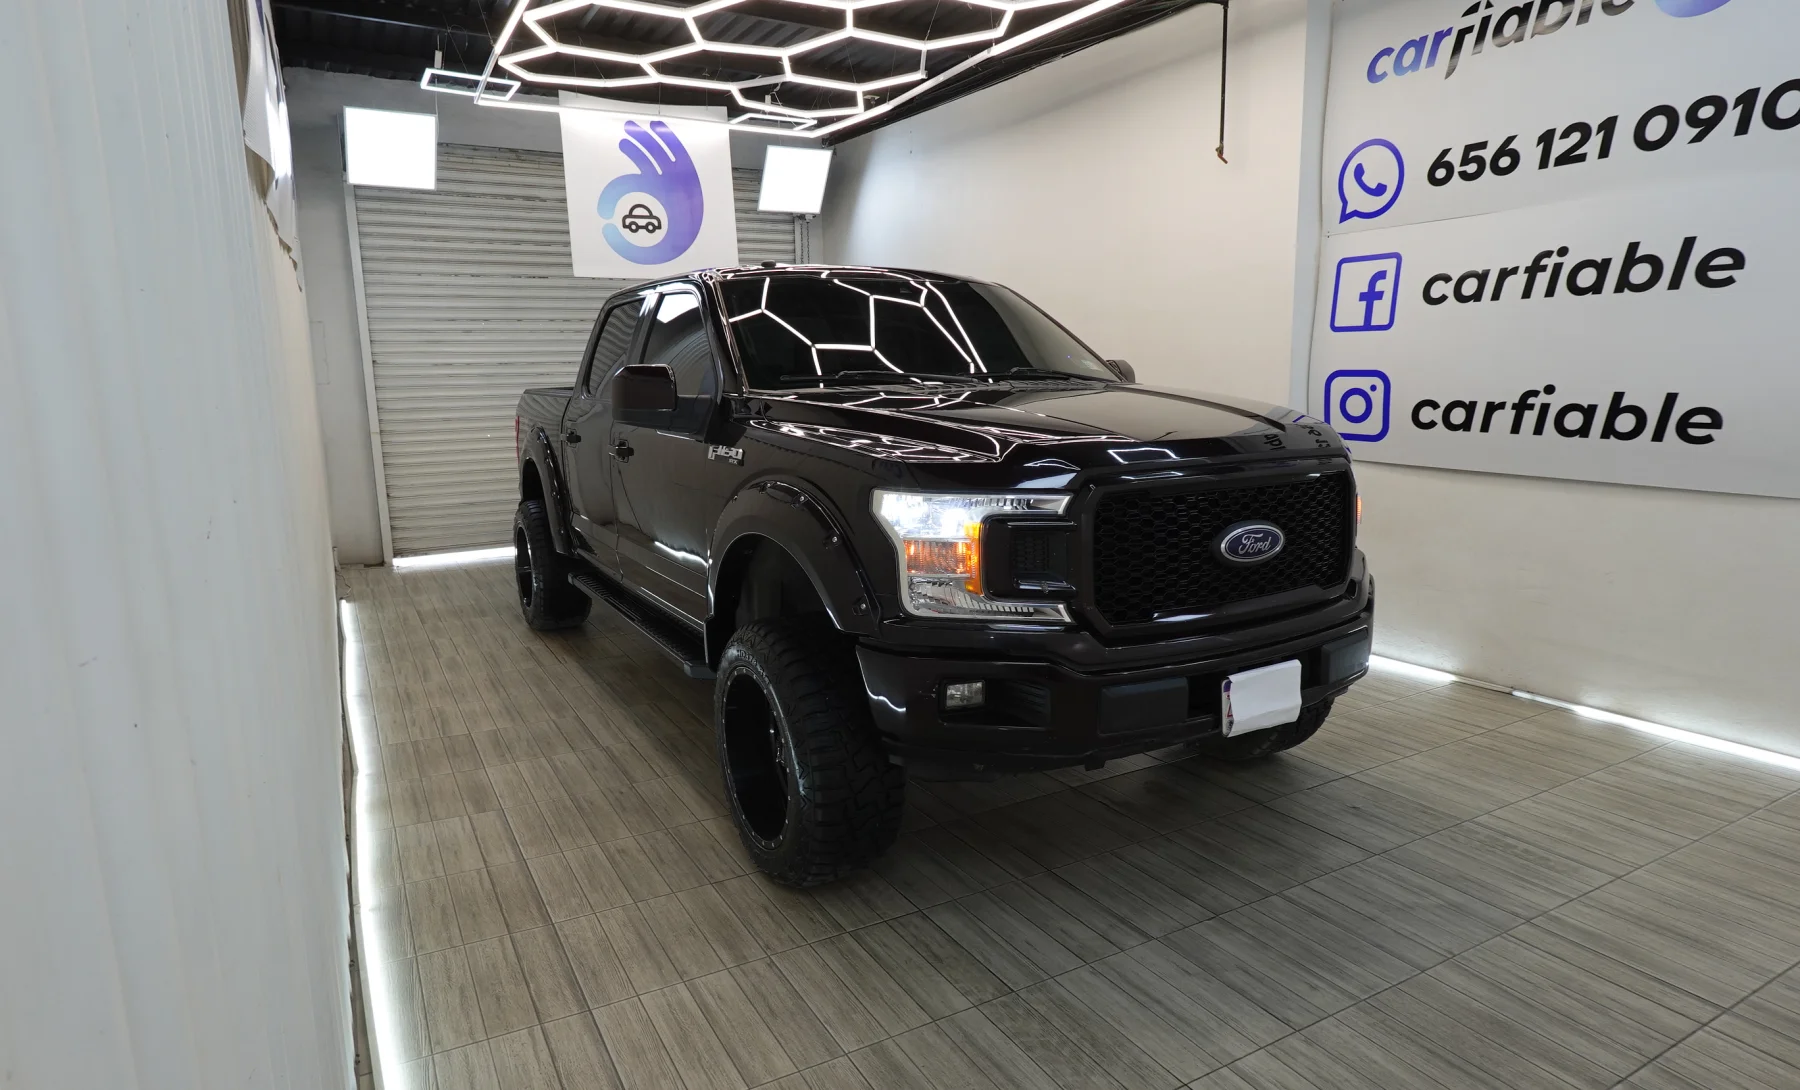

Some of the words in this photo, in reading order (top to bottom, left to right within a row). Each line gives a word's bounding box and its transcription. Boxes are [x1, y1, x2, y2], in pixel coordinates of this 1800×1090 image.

[1427, 134, 1521, 187] 656
[1536, 115, 1619, 170] 121
[1633, 78, 1800, 152] 0910
[1422, 235, 1746, 306] carfiable
[1410, 383, 1724, 446] carfiable
[1238, 533, 1272, 555] Ford
